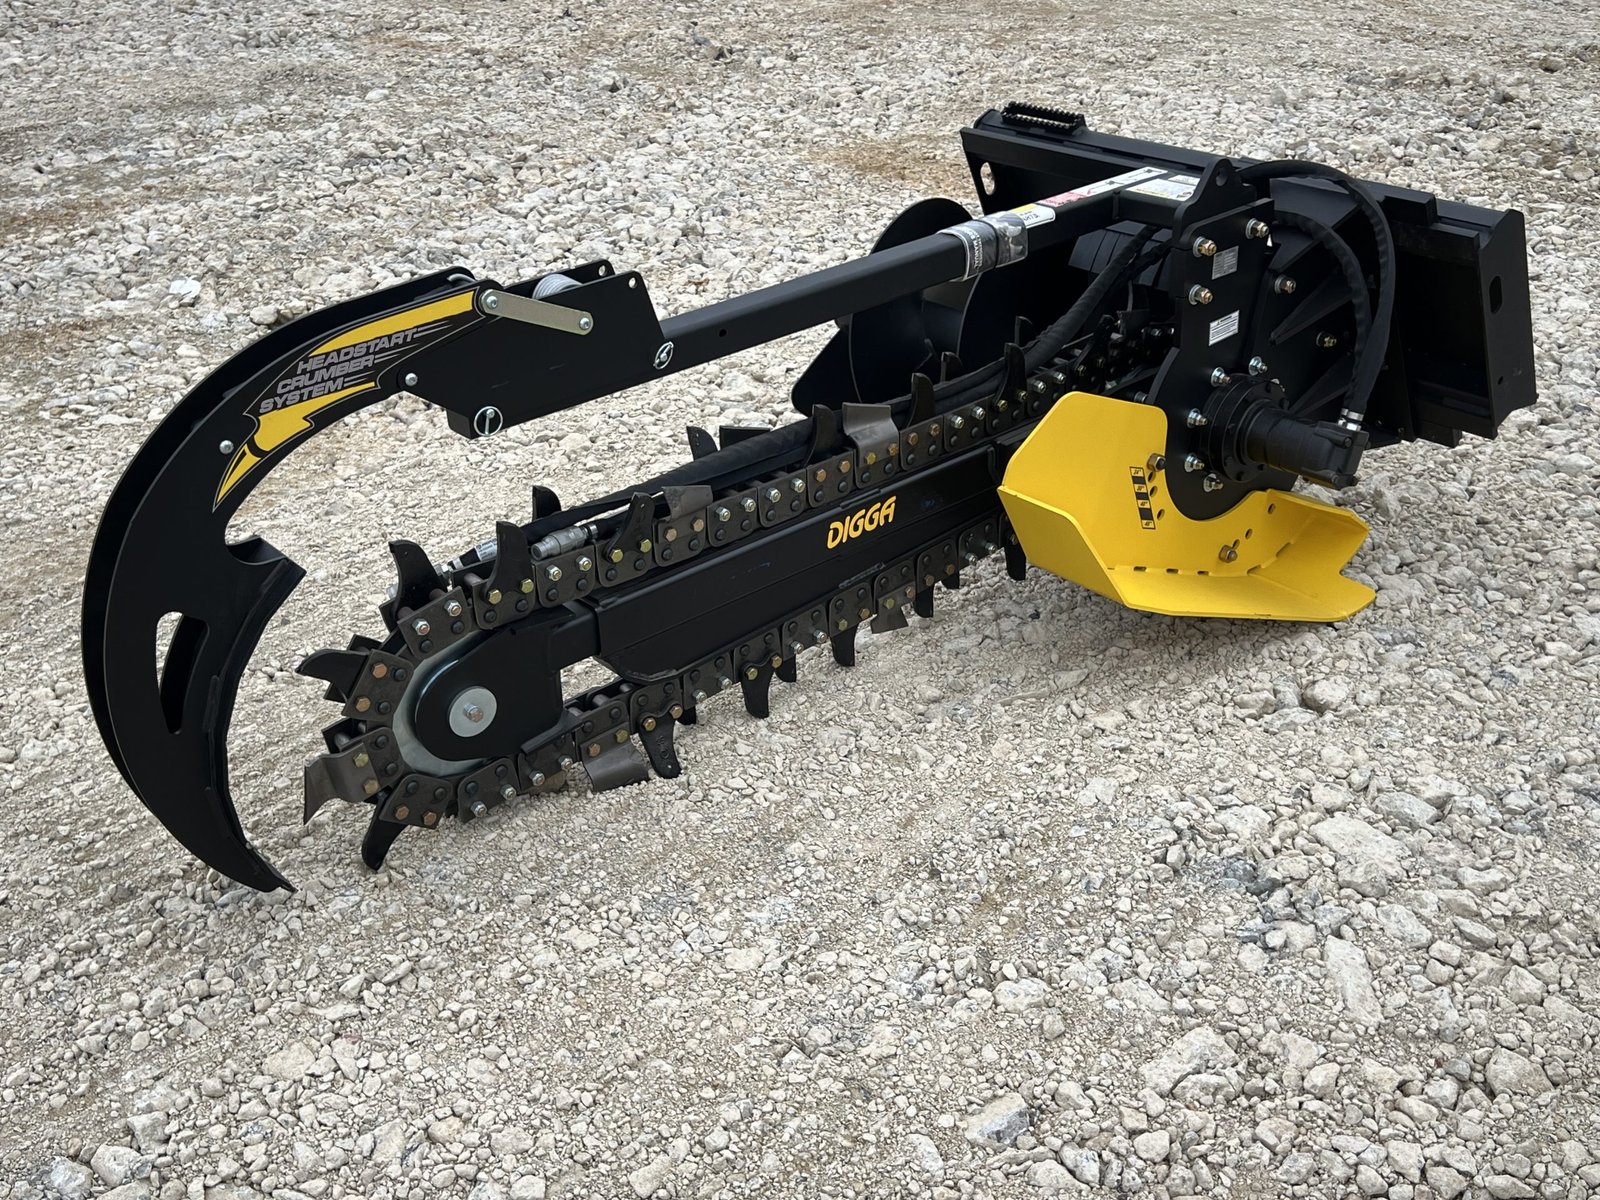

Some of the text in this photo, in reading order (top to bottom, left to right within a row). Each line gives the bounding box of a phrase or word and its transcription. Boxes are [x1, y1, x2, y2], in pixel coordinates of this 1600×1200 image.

[296, 328, 418, 374] HEADSTART
[259, 377, 344, 414] SYSTEM
[276, 354, 376, 395] CRUMBER
[827, 495, 897, 549] DIGGA
